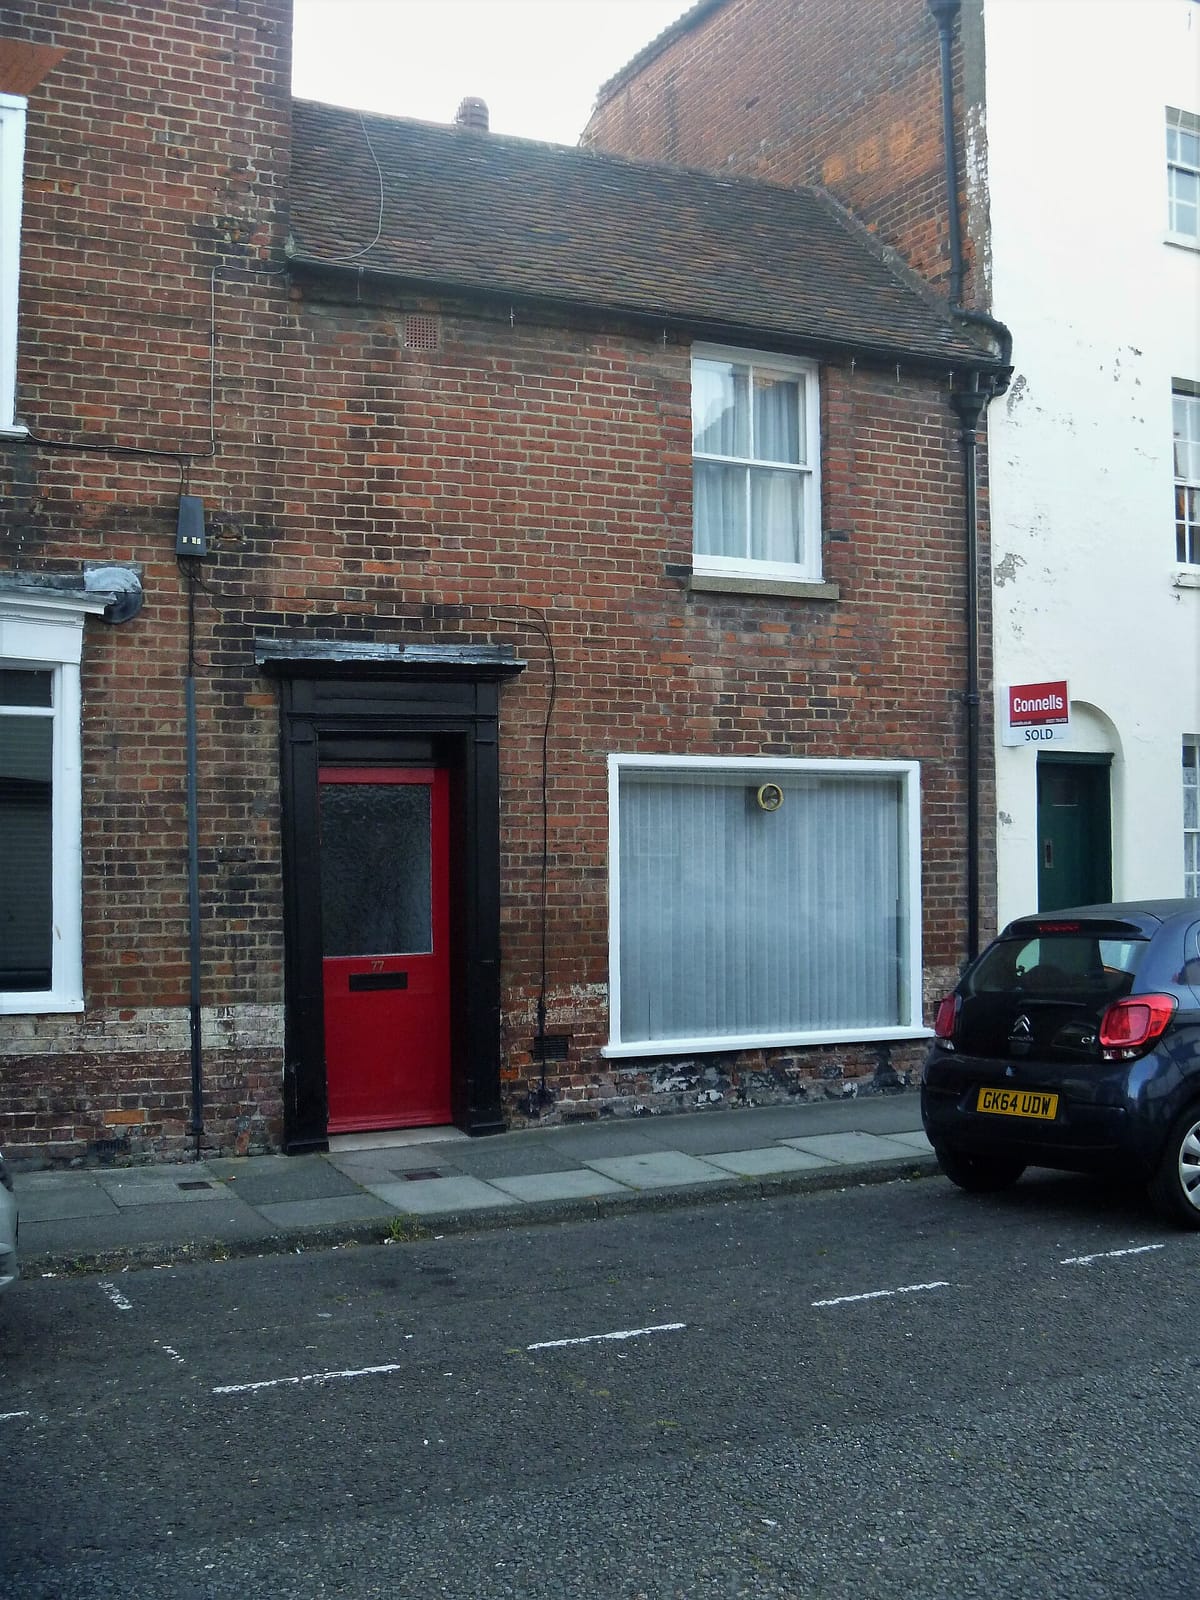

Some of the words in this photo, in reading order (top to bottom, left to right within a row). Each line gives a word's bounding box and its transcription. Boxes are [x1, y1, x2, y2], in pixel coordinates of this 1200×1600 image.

[1013, 694, 1063, 713] Connells
[1025, 728, 1053, 741] SOLD
[371, 960, 385, 972] 77
[983, 1092, 1018, 1112] GK64
[1021, 1095, 1051, 1115] UDW
